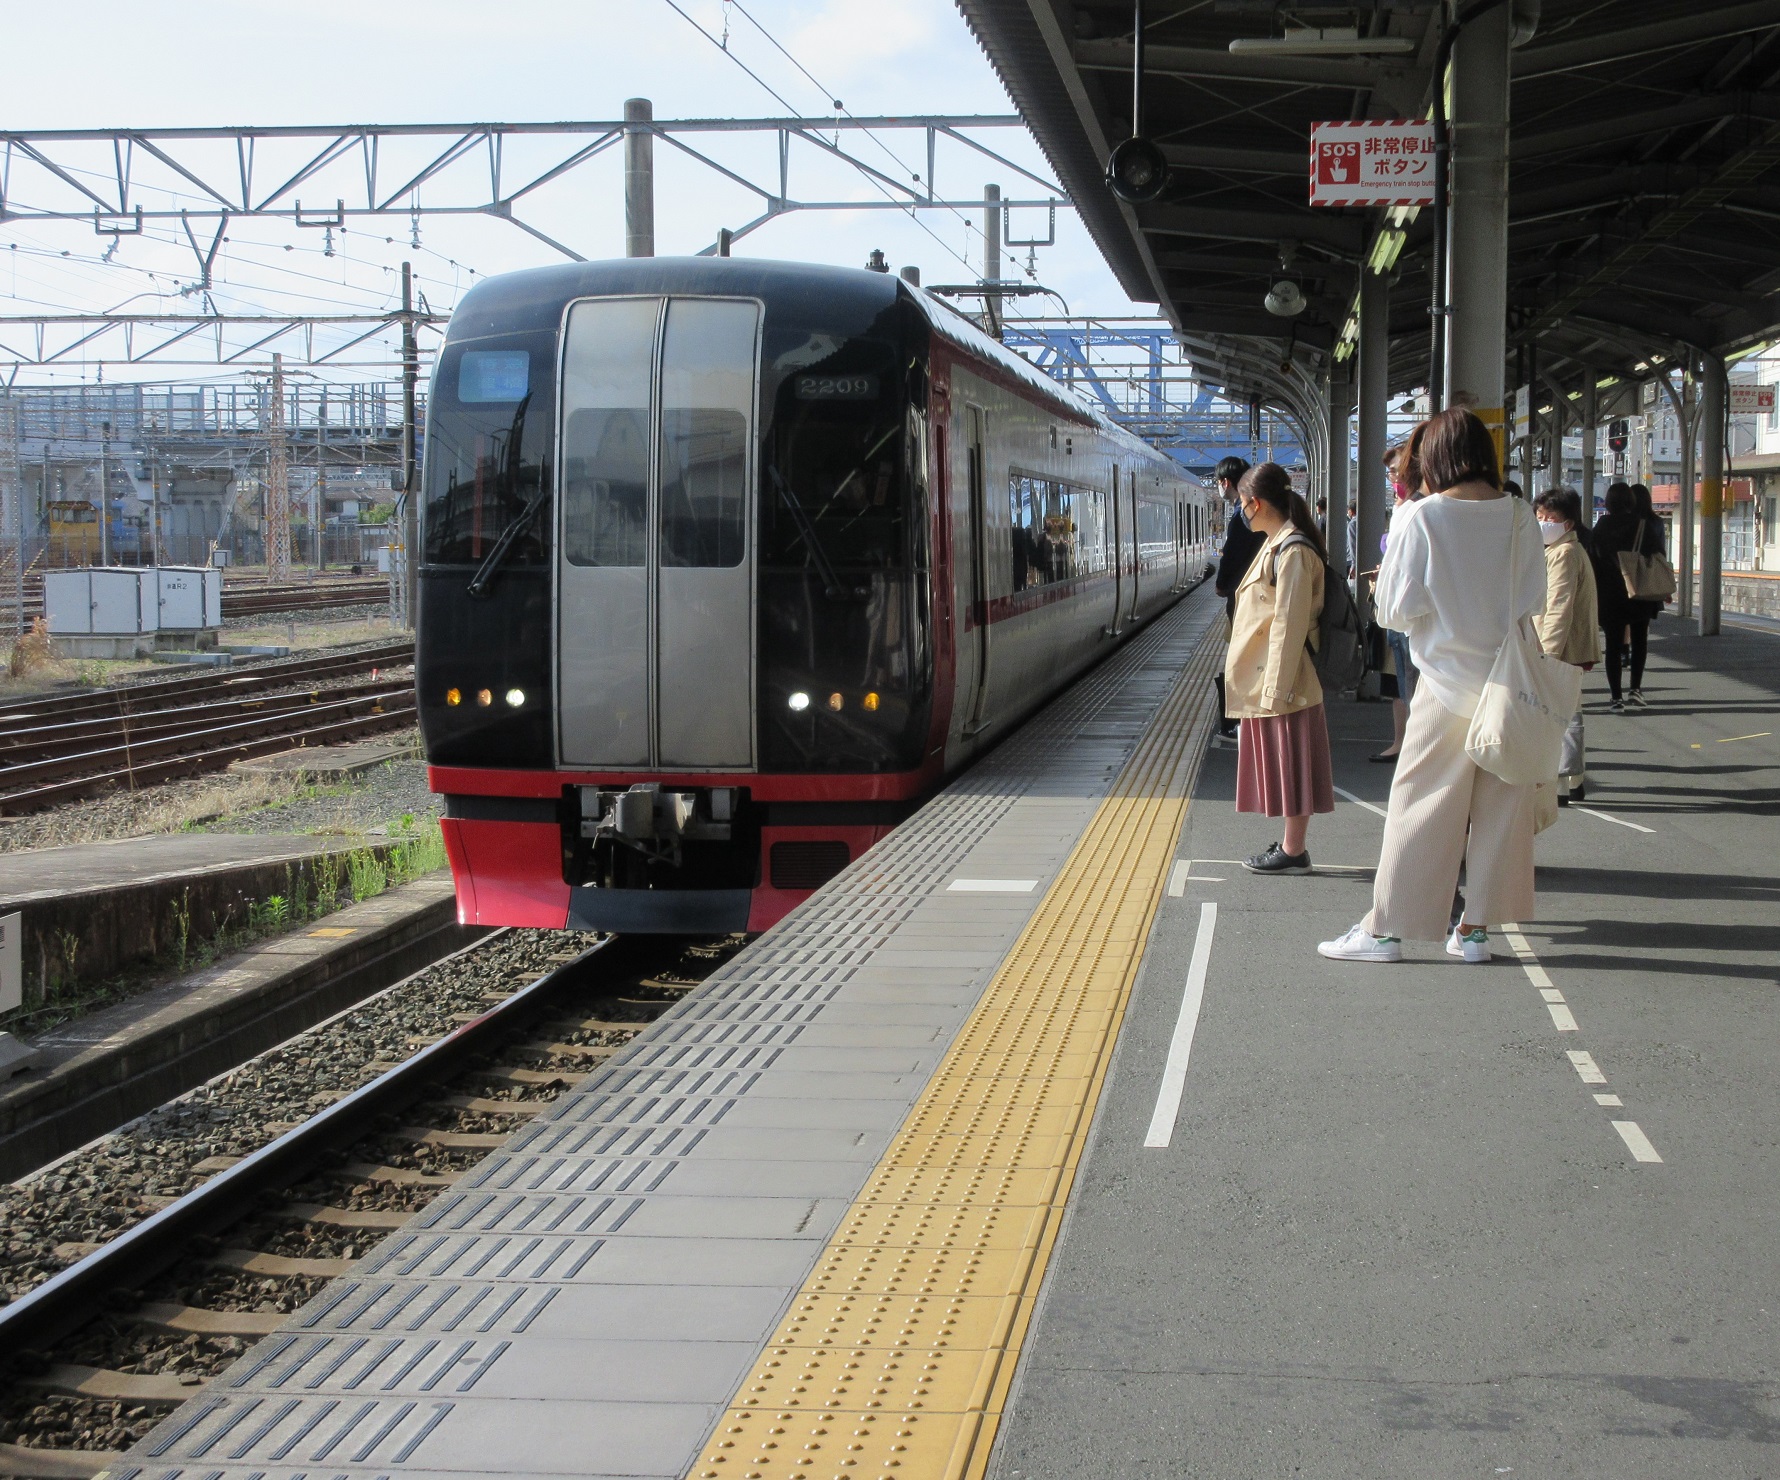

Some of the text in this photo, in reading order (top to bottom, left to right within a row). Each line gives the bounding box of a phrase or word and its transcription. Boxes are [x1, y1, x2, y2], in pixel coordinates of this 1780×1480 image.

[1323, 144, 1356, 156] SOS
[1364, 137, 1436, 155] 非常停止
[1374, 159, 1427, 175] ボタン
[1360, 180, 1392, 188] Emergency
[1407, 180, 1420, 188] stop
[1421, 179, 1436, 187] butto
[801, 378, 869, 394] 2209
